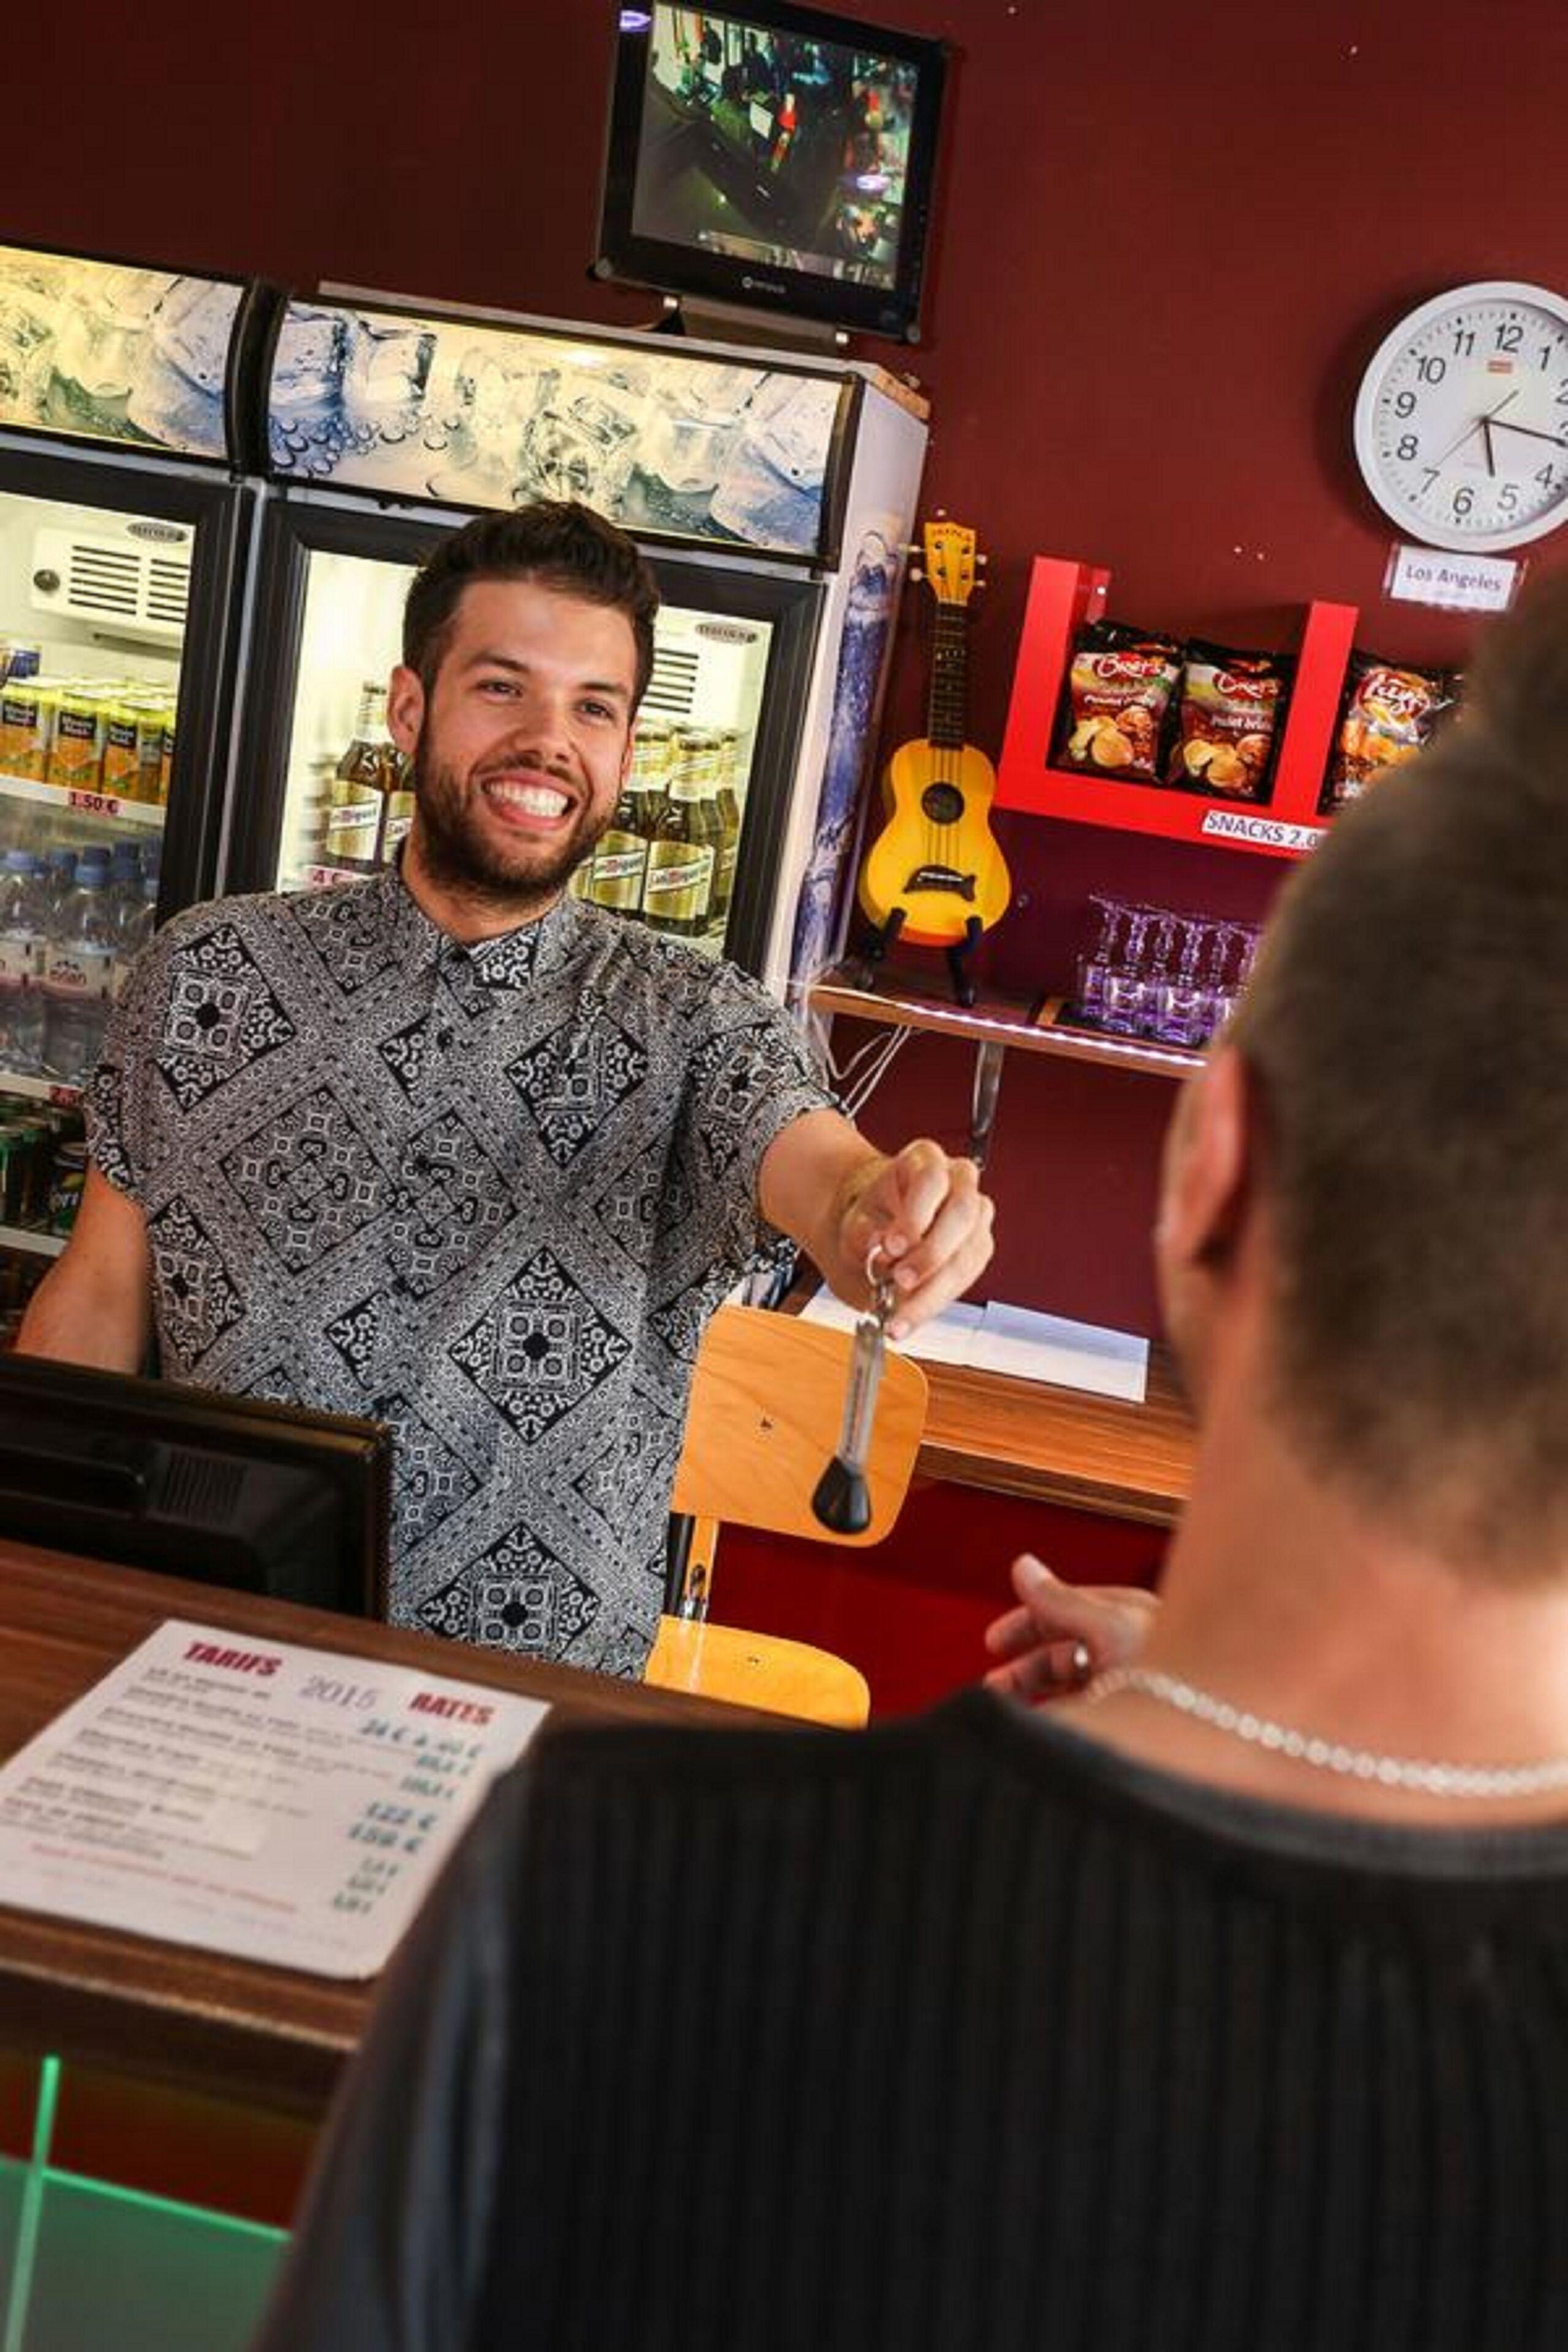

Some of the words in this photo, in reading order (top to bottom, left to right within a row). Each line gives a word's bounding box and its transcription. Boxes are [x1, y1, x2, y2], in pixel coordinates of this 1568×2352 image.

[1453, 330, 1476, 356] 11
[1496, 323, 1523, 353] 12
[1416, 355, 1446, 384] 10
[1540, 345, 1551, 371] 1
[1395, 391, 1417, 418] 9
[1397, 434, 1419, 461] 8
[1422, 467, 1440, 494] 7
[1535, 462, 1553, 489] 4
[1453, 488, 1474, 514] 6
[1498, 483, 1519, 510] 5
[1406, 564, 1432, 581] Los
[1438, 568, 1501, 590] Angeles
[1207, 812, 1284, 842] SNACKS
[184, 1642, 282, 1676] TARIFS
[298, 1675, 380, 1709] 2015
[409, 1692, 495, 1726] RATES
